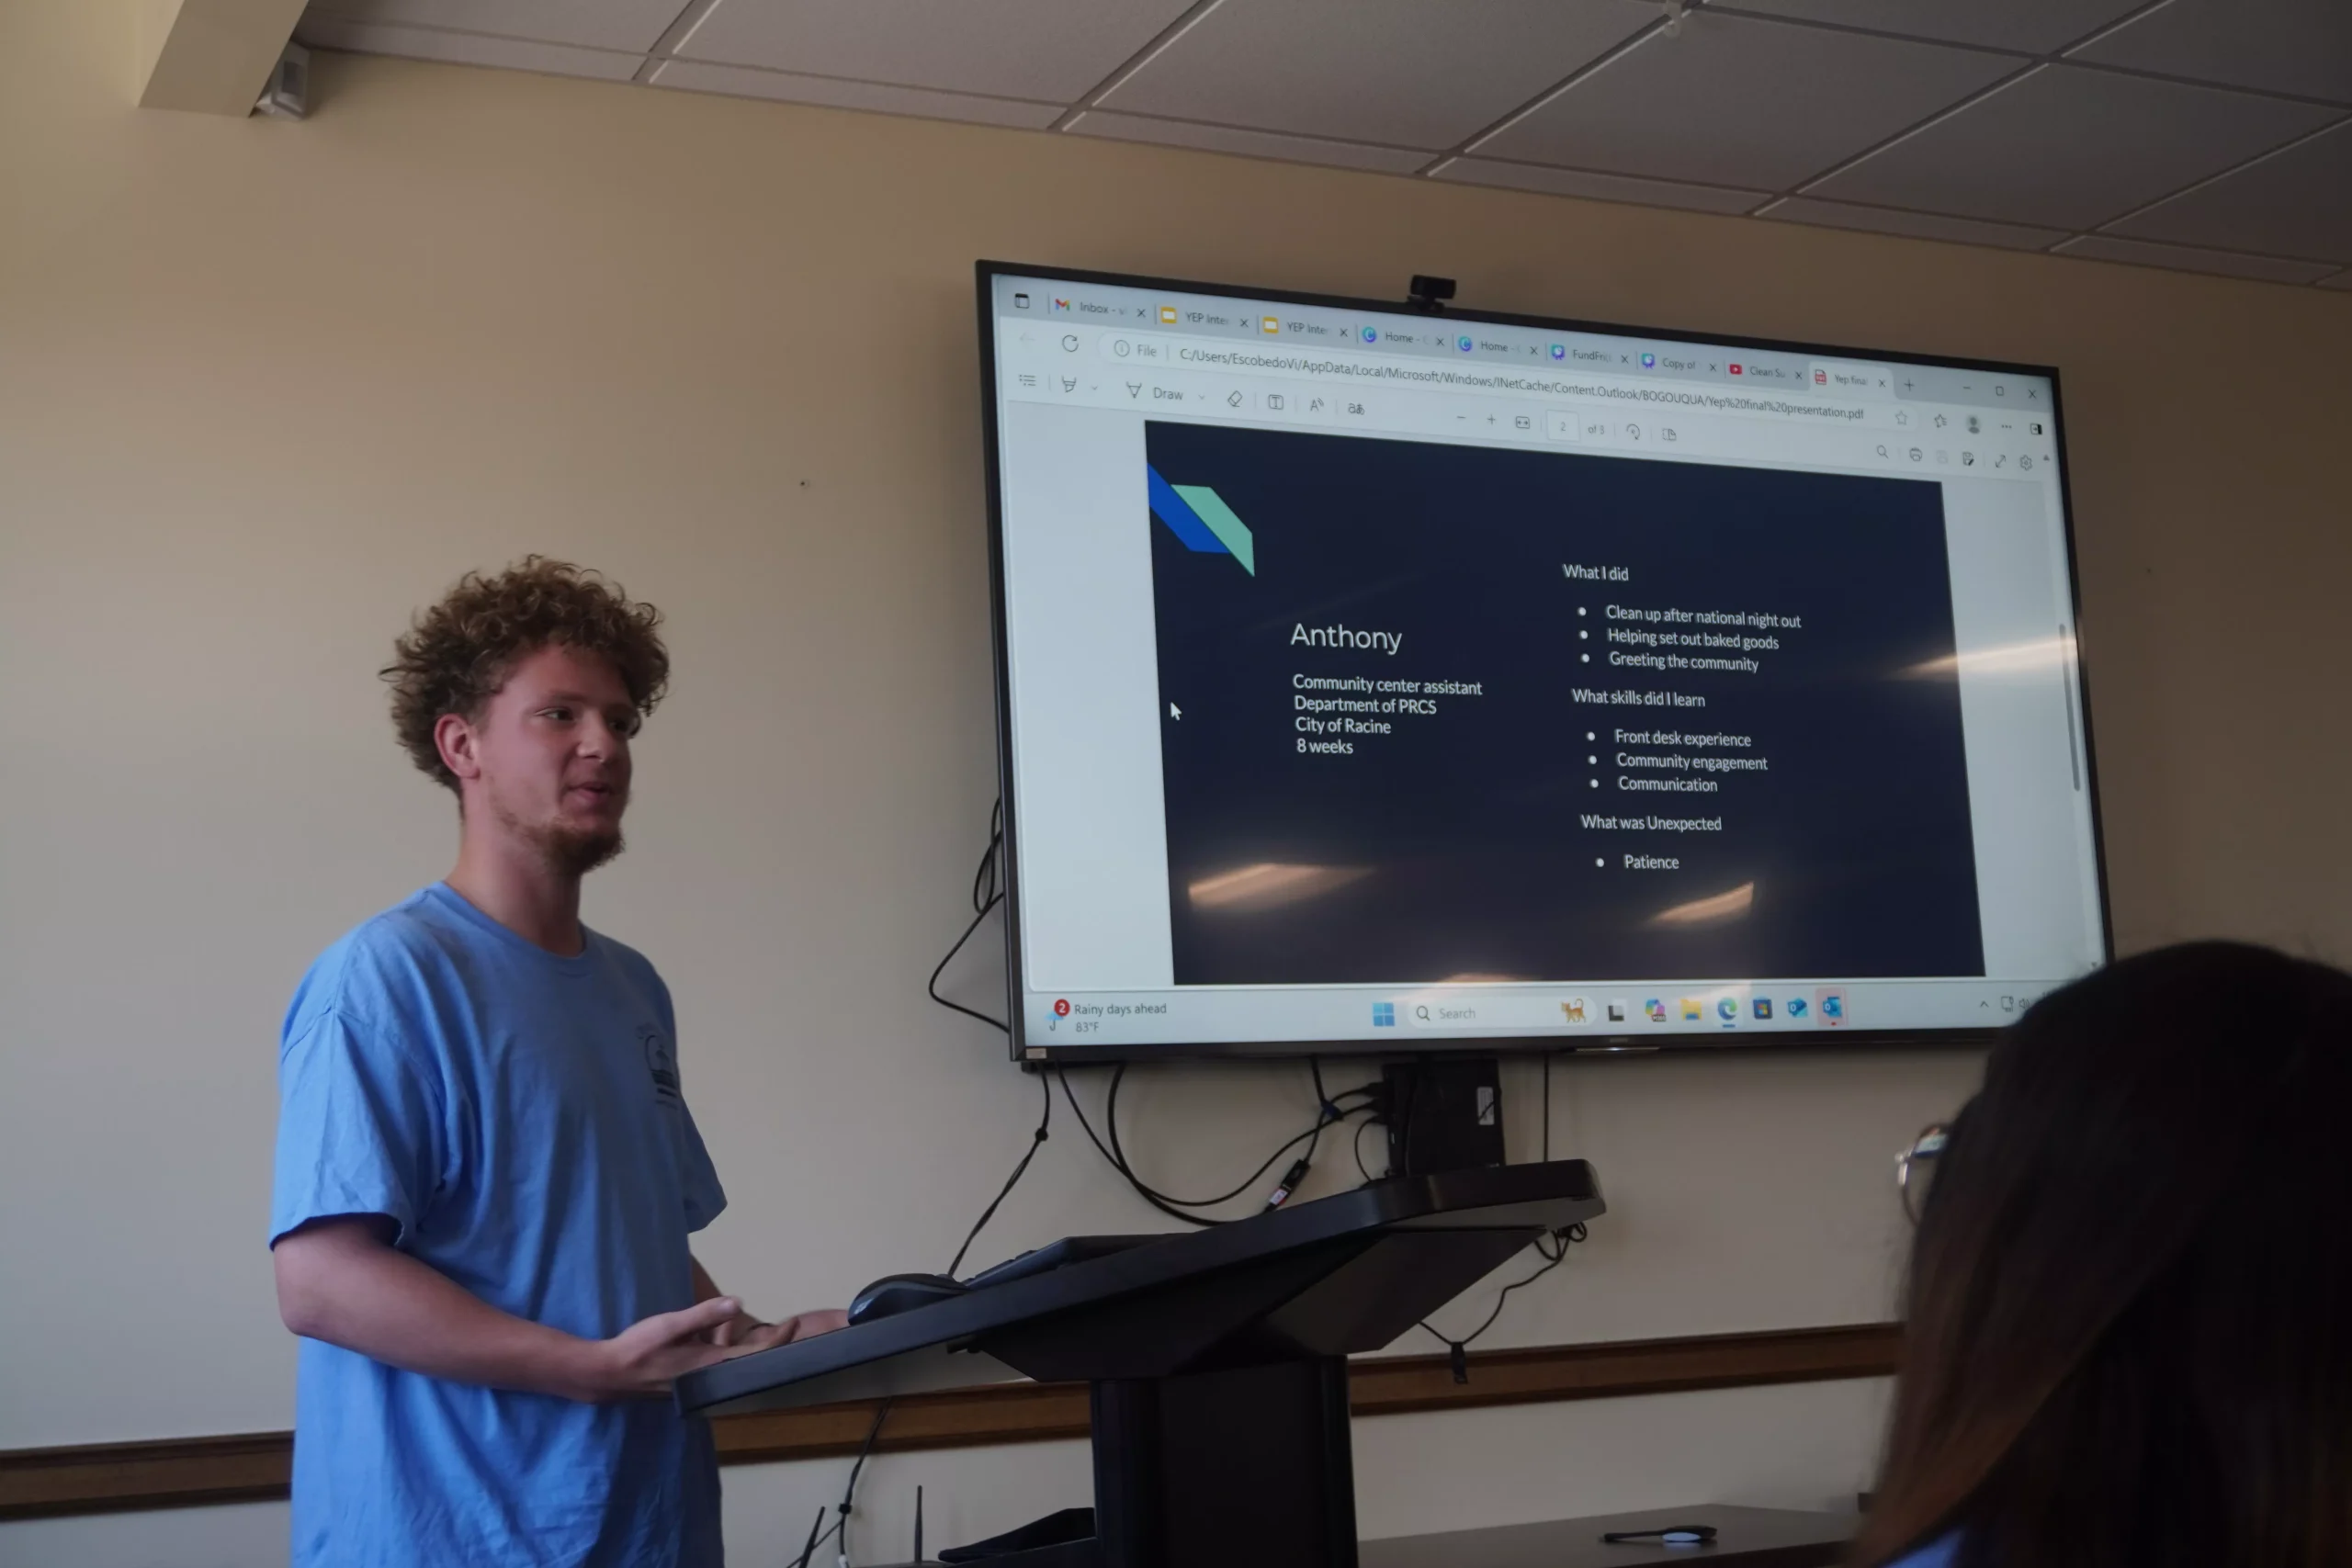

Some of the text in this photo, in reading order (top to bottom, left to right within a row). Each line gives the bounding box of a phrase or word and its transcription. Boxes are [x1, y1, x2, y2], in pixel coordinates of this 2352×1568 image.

[1080, 301, 1109, 313] Inbox
[1185, 311, 1204, 323] YEP
[1287, 321, 1306, 333] YEP
[1385, 332, 1414, 344] Home
[1137, 344, 1158, 357] File
[1480, 341, 1508, 353] Home
[1662, 357, 1696, 370] Copy of
[1749, 366, 1773, 378] Clean
[1153, 387, 1183, 400] Draw
[1561, 422, 1566, 432] 2
[1588, 424, 1597, 434] of
[1563, 564, 1629, 581] What I did
[1606, 604, 1802, 629] Clean up after national night out
[1290, 623, 1403, 656] Anthony
[1608, 628, 1780, 650] Helping set out baked goods
[1610, 651, 1758, 673] Greeting the community
[1293, 673, 1483, 695] Community center assistant
[1294, 695, 1437, 715] Department of PRCS
[1571, 689, 1705, 707] What skills did I learn
[1295, 716, 1391, 735] City of Racine
[1614, 728, 1751, 748] Front desk experience
[1296, 738, 1353, 754] 8 weeks
[1616, 752, 1768, 773] Community engagement
[1618, 775, 1718, 792] Communication
[1580, 814, 1722, 832] What was Unexpected
[1624, 854, 1679, 869] Patience
[1058, 1003, 1067, 1014] 2
[1074, 1003, 1167, 1017] Rainy days ahead
[1439, 1008, 1476, 1020] Search
[1075, 1021, 1100, 1032] 83°F
